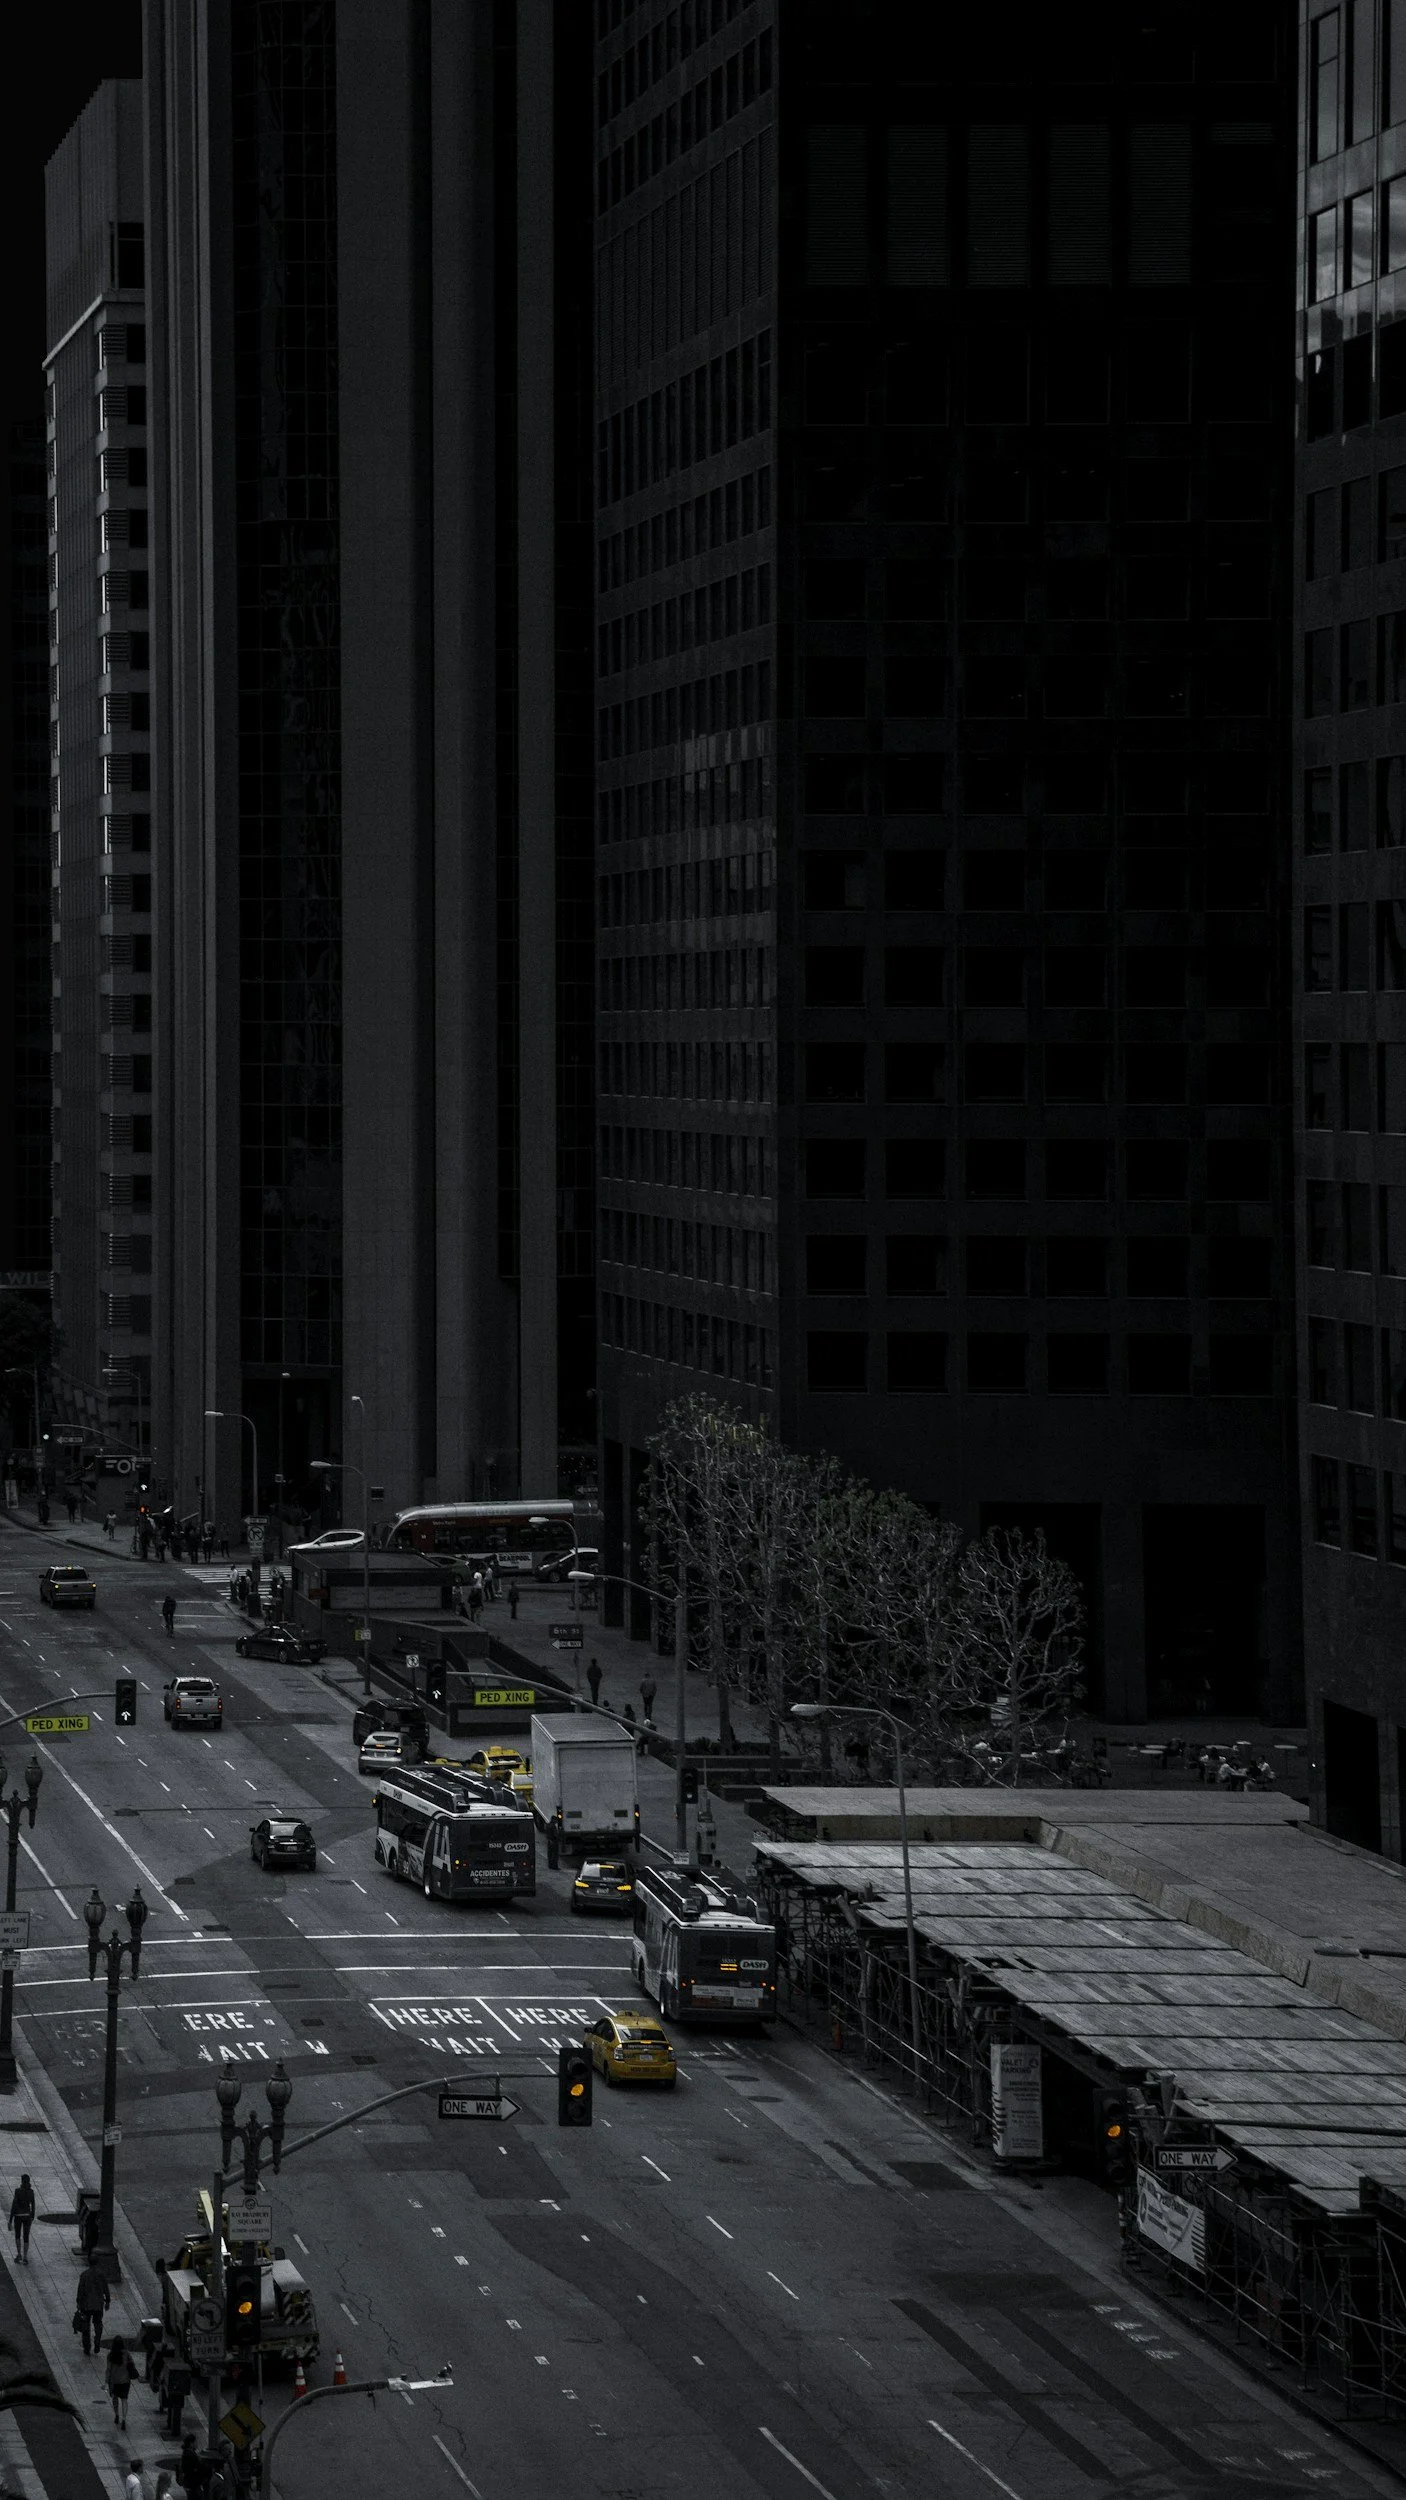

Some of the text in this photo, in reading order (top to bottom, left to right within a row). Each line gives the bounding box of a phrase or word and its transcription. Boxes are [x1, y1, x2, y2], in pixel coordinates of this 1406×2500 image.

[480, 1692, 530, 1702] PED XING
[32, 1718, 84, 1730] PED XING
[469, 1869, 510, 1877] ACCIDENTES
[182, 2011, 254, 2031] ERE
[388, 2007, 483, 2025] HERE
[505, 2007, 599, 2025] HERE
[1001, 2058, 1023, 2066] VALET
[1001, 2066, 1032, 2074] PARKING
[444, 2100, 501, 2114] ONE WAY
[1160, 2152, 1217, 2165] ONE WAY
[193, 2335, 223, 2344] NO LEFT
[196, 2346, 220, 2354] TURN
